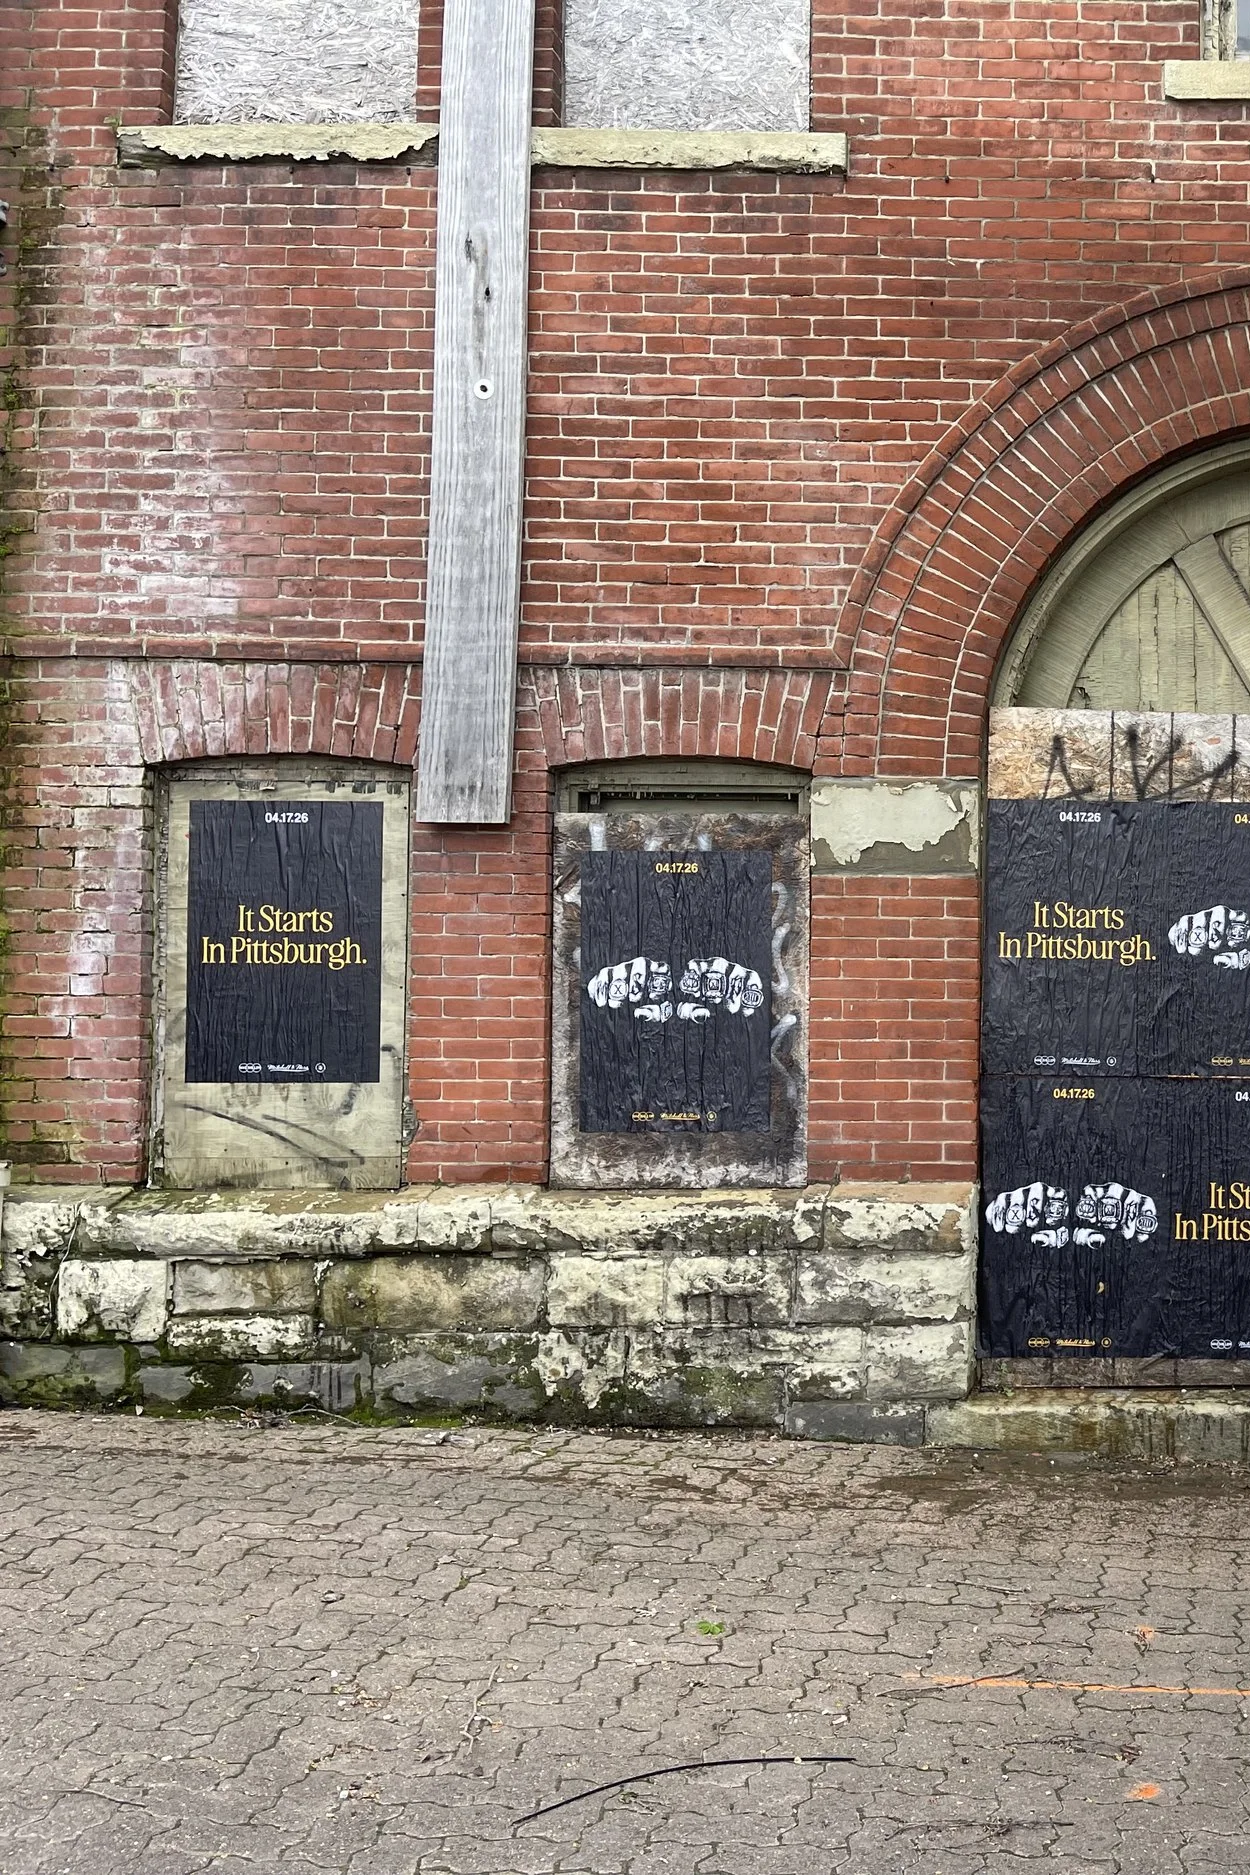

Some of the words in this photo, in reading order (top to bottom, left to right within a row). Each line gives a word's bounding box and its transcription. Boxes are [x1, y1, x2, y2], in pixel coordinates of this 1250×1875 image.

[264, 811, 309, 824] 04.17.26
[1059, 811, 1102, 823] 04.17.26
[655, 862, 699, 874] 04.17.26
[238, 905, 255, 932] It
[259, 905, 333, 932] Starts
[1034, 902, 1049, 927] It
[1053, 902, 1124, 929] Starts
[202, 937, 225, 963] In
[231, 937, 366, 970] Pittsburgh.
[999, 932, 1021, 958] In
[1026, 932, 1156, 966] Pittsburgh.
[1053, 1088, 1095, 1099] 04.17.26
[1210, 1182, 1225, 1208] It
[1175, 1213, 1197, 1239] In
